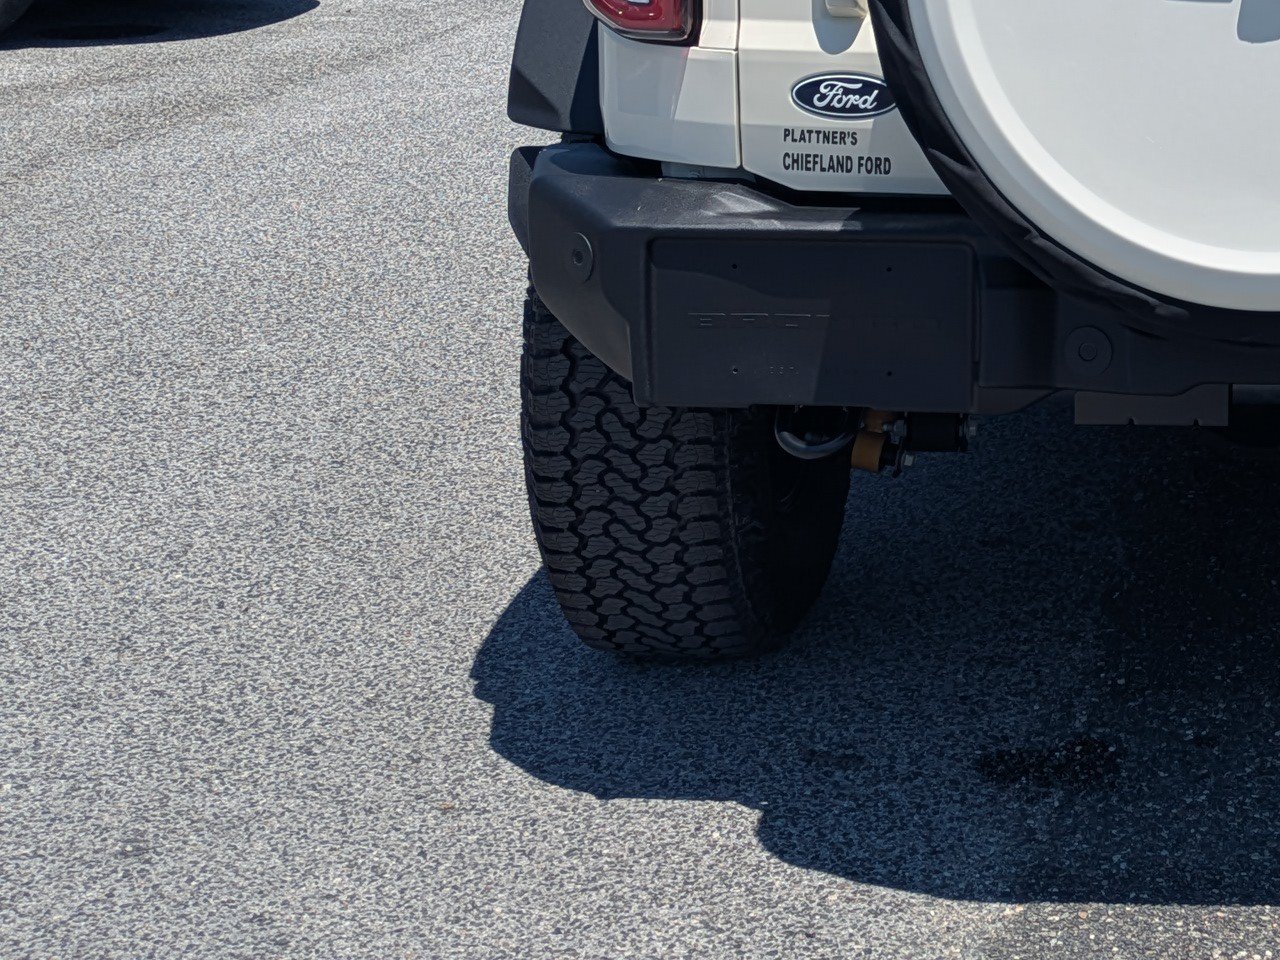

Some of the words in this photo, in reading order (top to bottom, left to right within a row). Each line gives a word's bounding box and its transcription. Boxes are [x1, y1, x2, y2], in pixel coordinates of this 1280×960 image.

[813, 80, 879, 109] Ford
[783, 128, 858, 146] PLATTNER'S
[782, 152, 853, 174] CHIEFLAND
[858, 156, 892, 175] FORD
